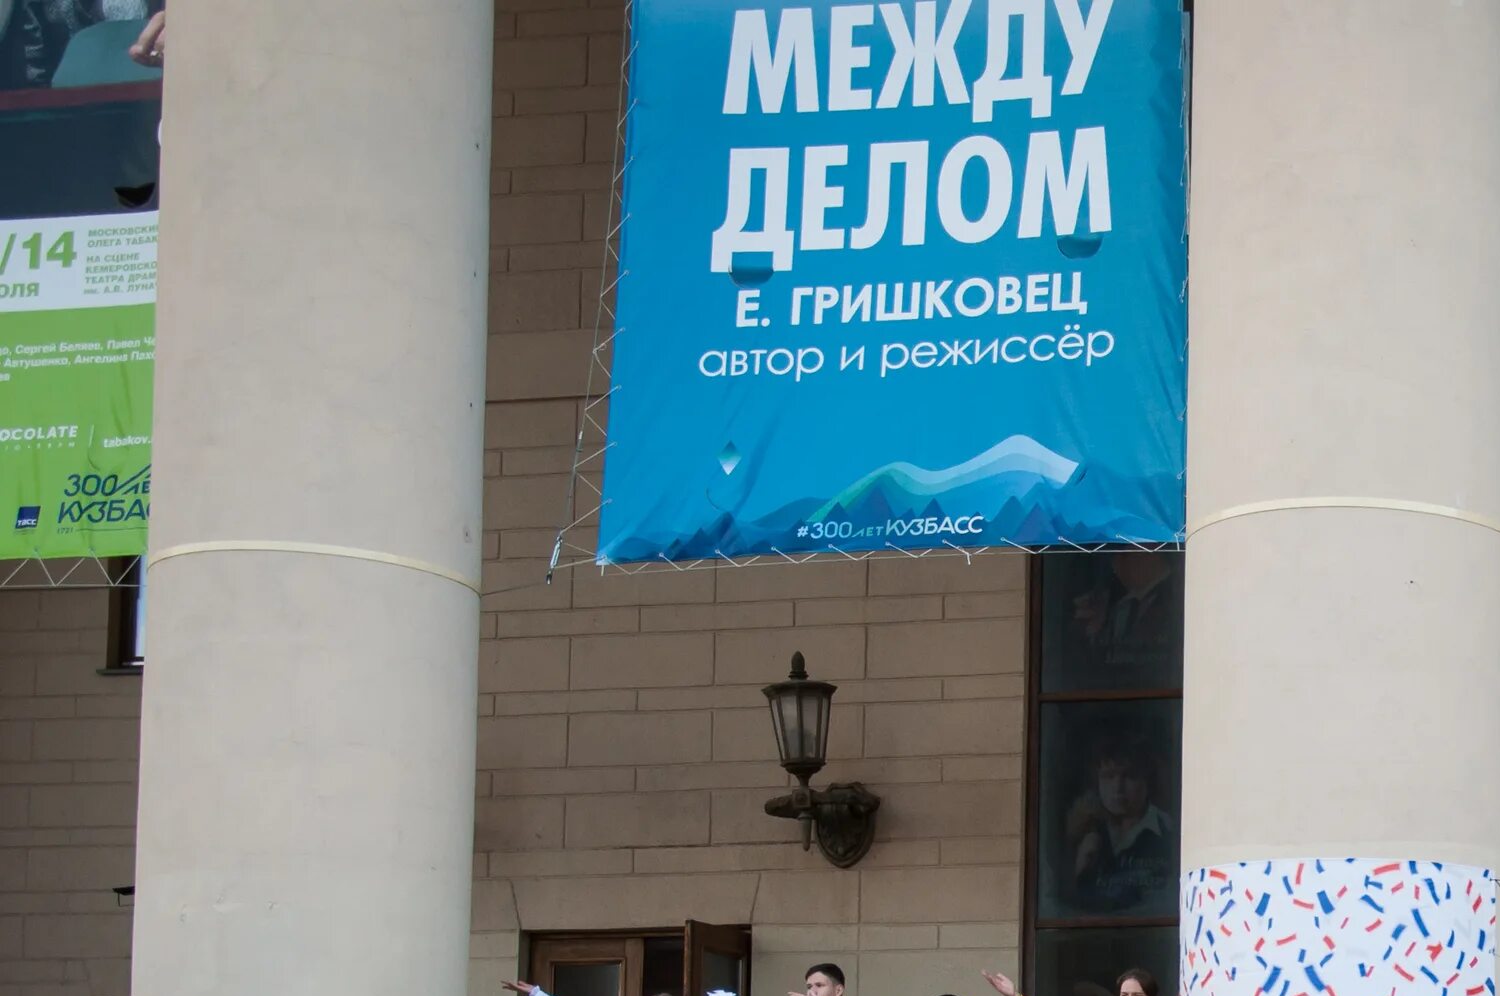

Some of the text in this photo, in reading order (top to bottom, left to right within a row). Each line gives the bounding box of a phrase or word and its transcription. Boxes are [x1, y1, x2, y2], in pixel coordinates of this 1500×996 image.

[722, 0, 1111, 122] МЕЖДУ
[711, 126, 1113, 272] ДЕЛОМ
[87, 238, 121, 248] ОЛЕГА
[86, 253, 140, 263] НА СЦЕНЕ
[85, 274, 125, 284] ТЕАТРА
[736, 272, 1088, 327] Е. ГРИШКОВЕЦ
[16, 343, 56, 356] Сергей
[107, 339, 140, 350] Павел
[699, 325, 1115, 382] автор и режиссёр
[63, 474, 119, 497] 300
[57, 499, 151, 524] КУЗБА
